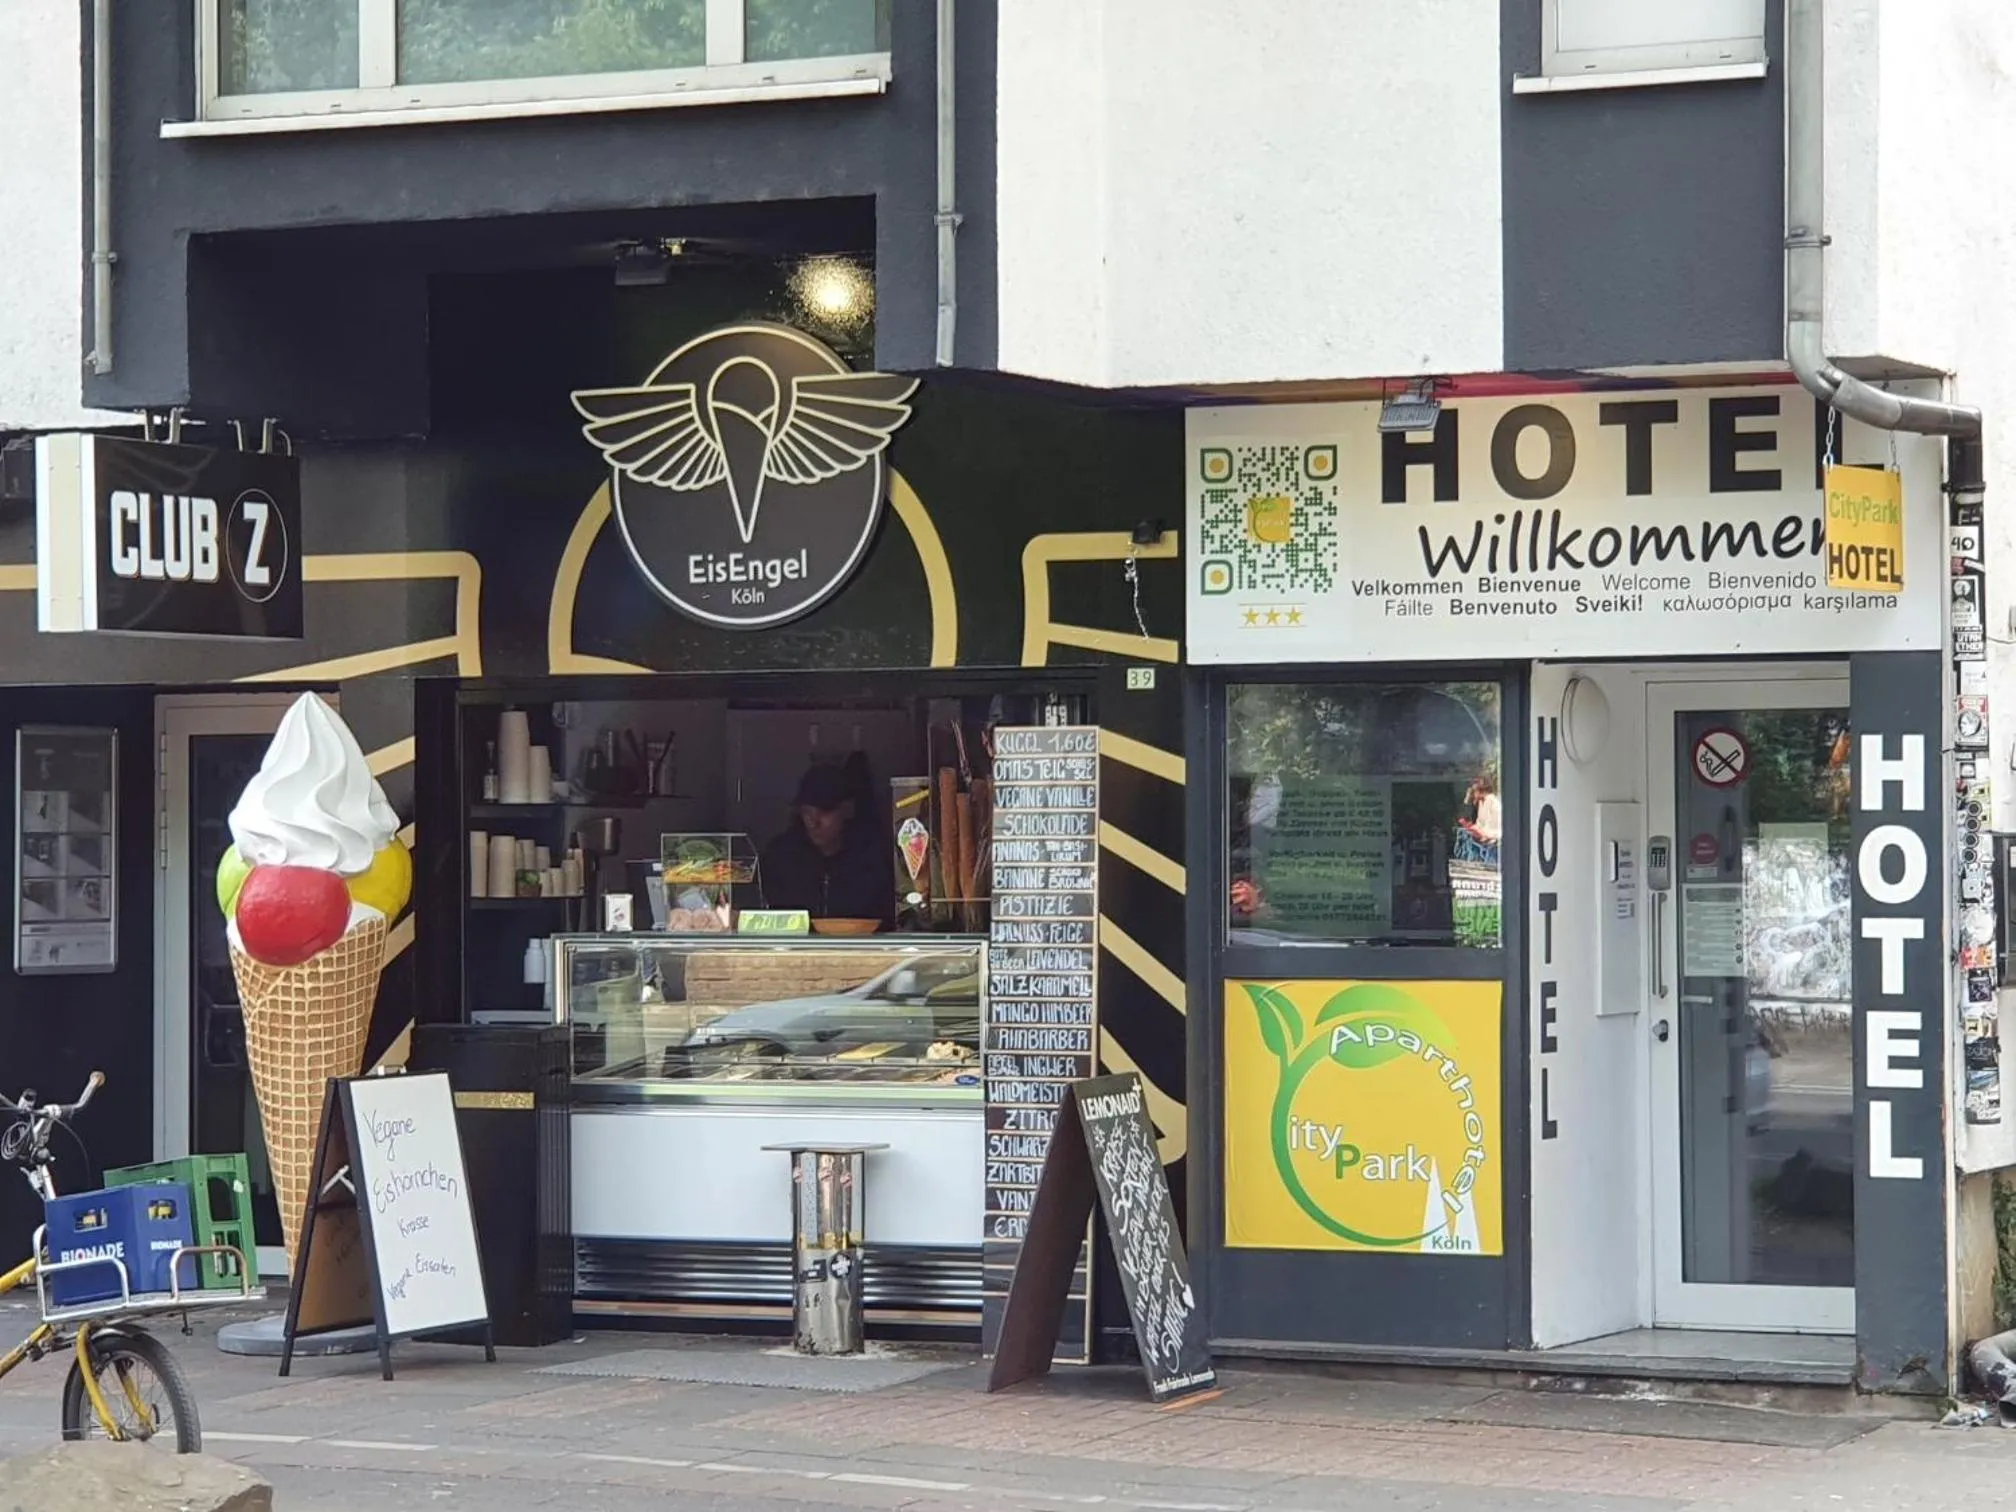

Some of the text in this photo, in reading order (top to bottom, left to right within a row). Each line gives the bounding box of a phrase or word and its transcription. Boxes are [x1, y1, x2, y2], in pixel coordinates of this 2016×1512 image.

[1829, 491, 1900, 527] CityPark
[110, 490, 271, 585] CLUB Z
[688, 549, 807, 588] EisEngel
[1829, 543, 1902, 584] HOTEL
[731, 588, 765, 605] Köln
[1352, 571, 1817, 597] Velkommen Bienvenue Welcome Bienvenido
[1450, 599, 1558, 616] Benvenuto
[1575, 593, 1643, 613] Sveiki!
[1804, 592, 1898, 614] karşılama
[1131, 670, 1152, 687] 39
[1537, 716, 1558, 1140] HOTEL
[1858, 734, 1928, 1179] HOTEL
[1023, 1056, 1077, 1077] INGWER
[1335, 1144, 1431, 1181] Park
[1432, 1235, 1472, 1251] Köln
